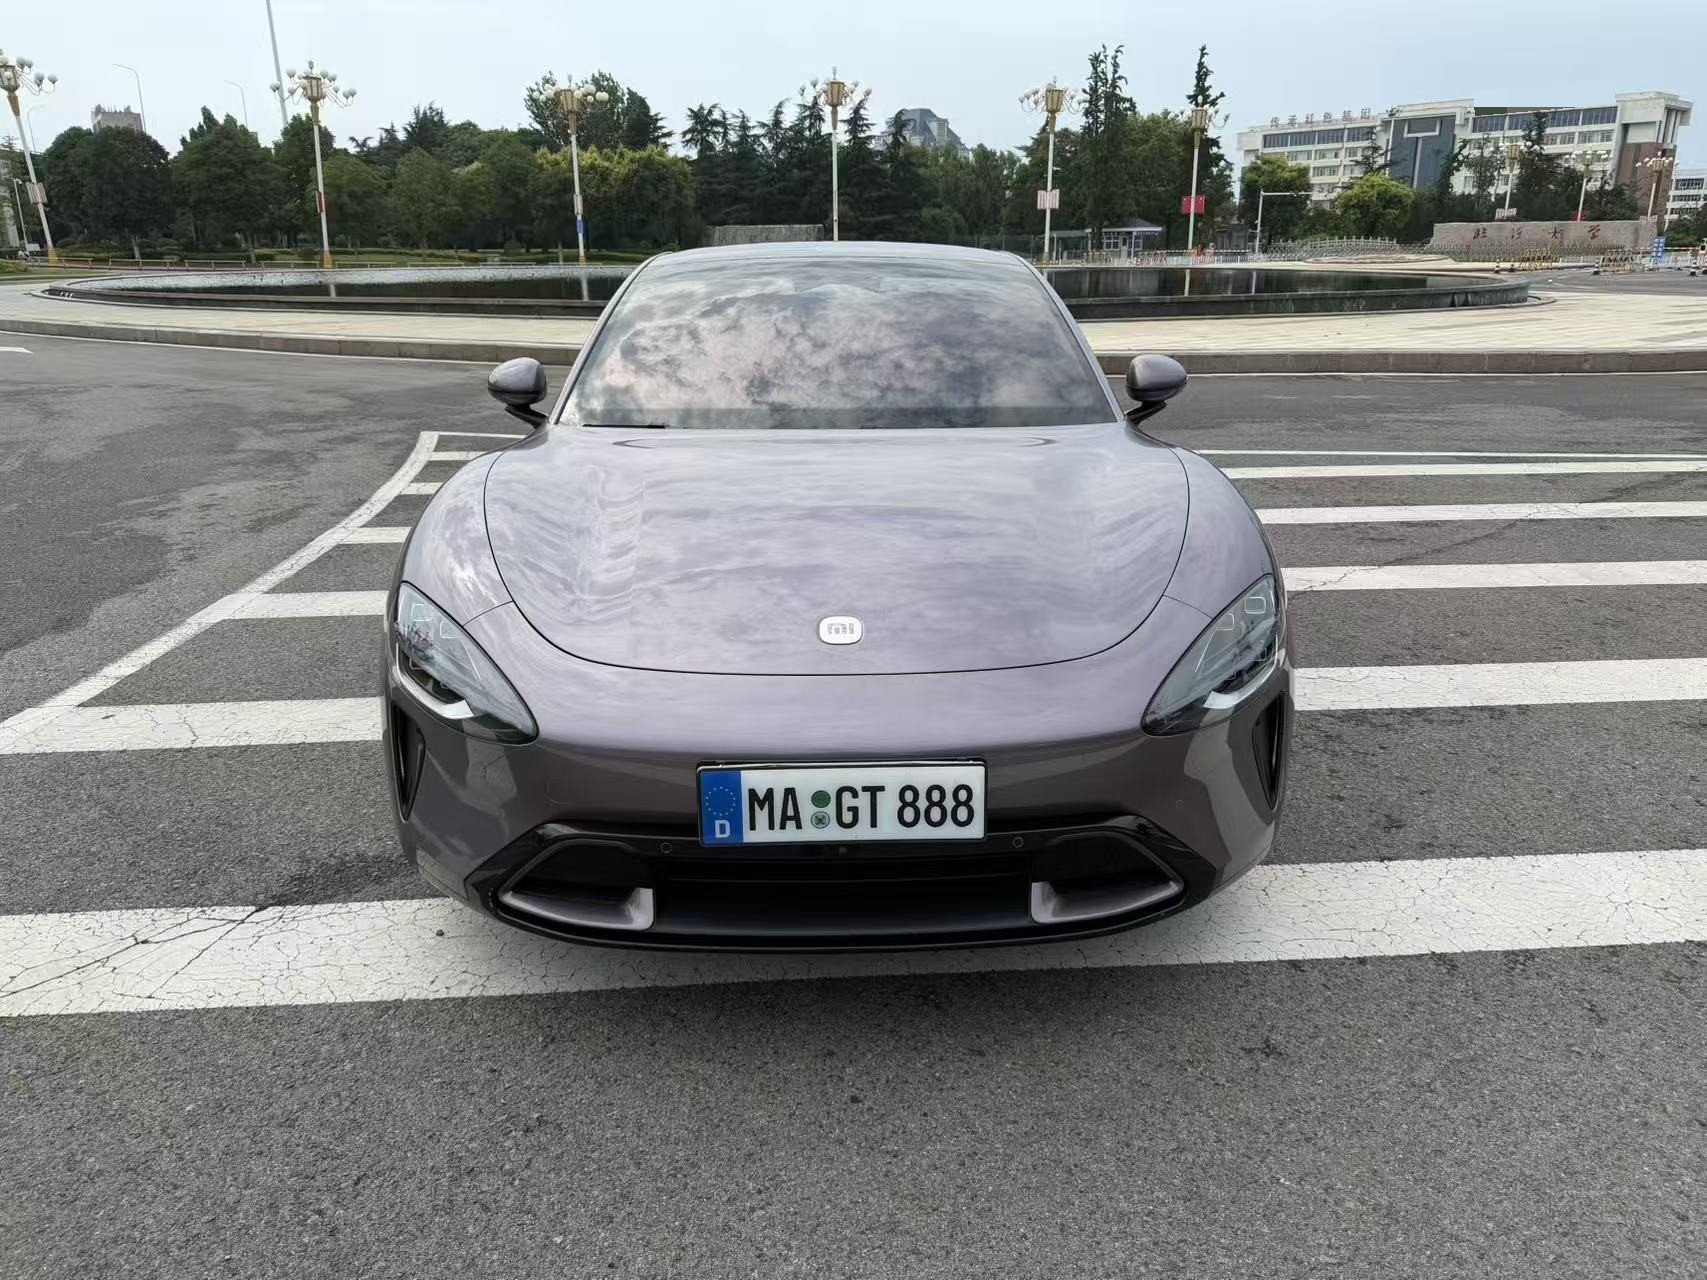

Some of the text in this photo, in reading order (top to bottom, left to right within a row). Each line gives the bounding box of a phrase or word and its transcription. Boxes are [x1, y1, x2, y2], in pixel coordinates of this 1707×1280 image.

[748, 784, 975, 831] MA GT 888
[714, 819, 730, 839] D
